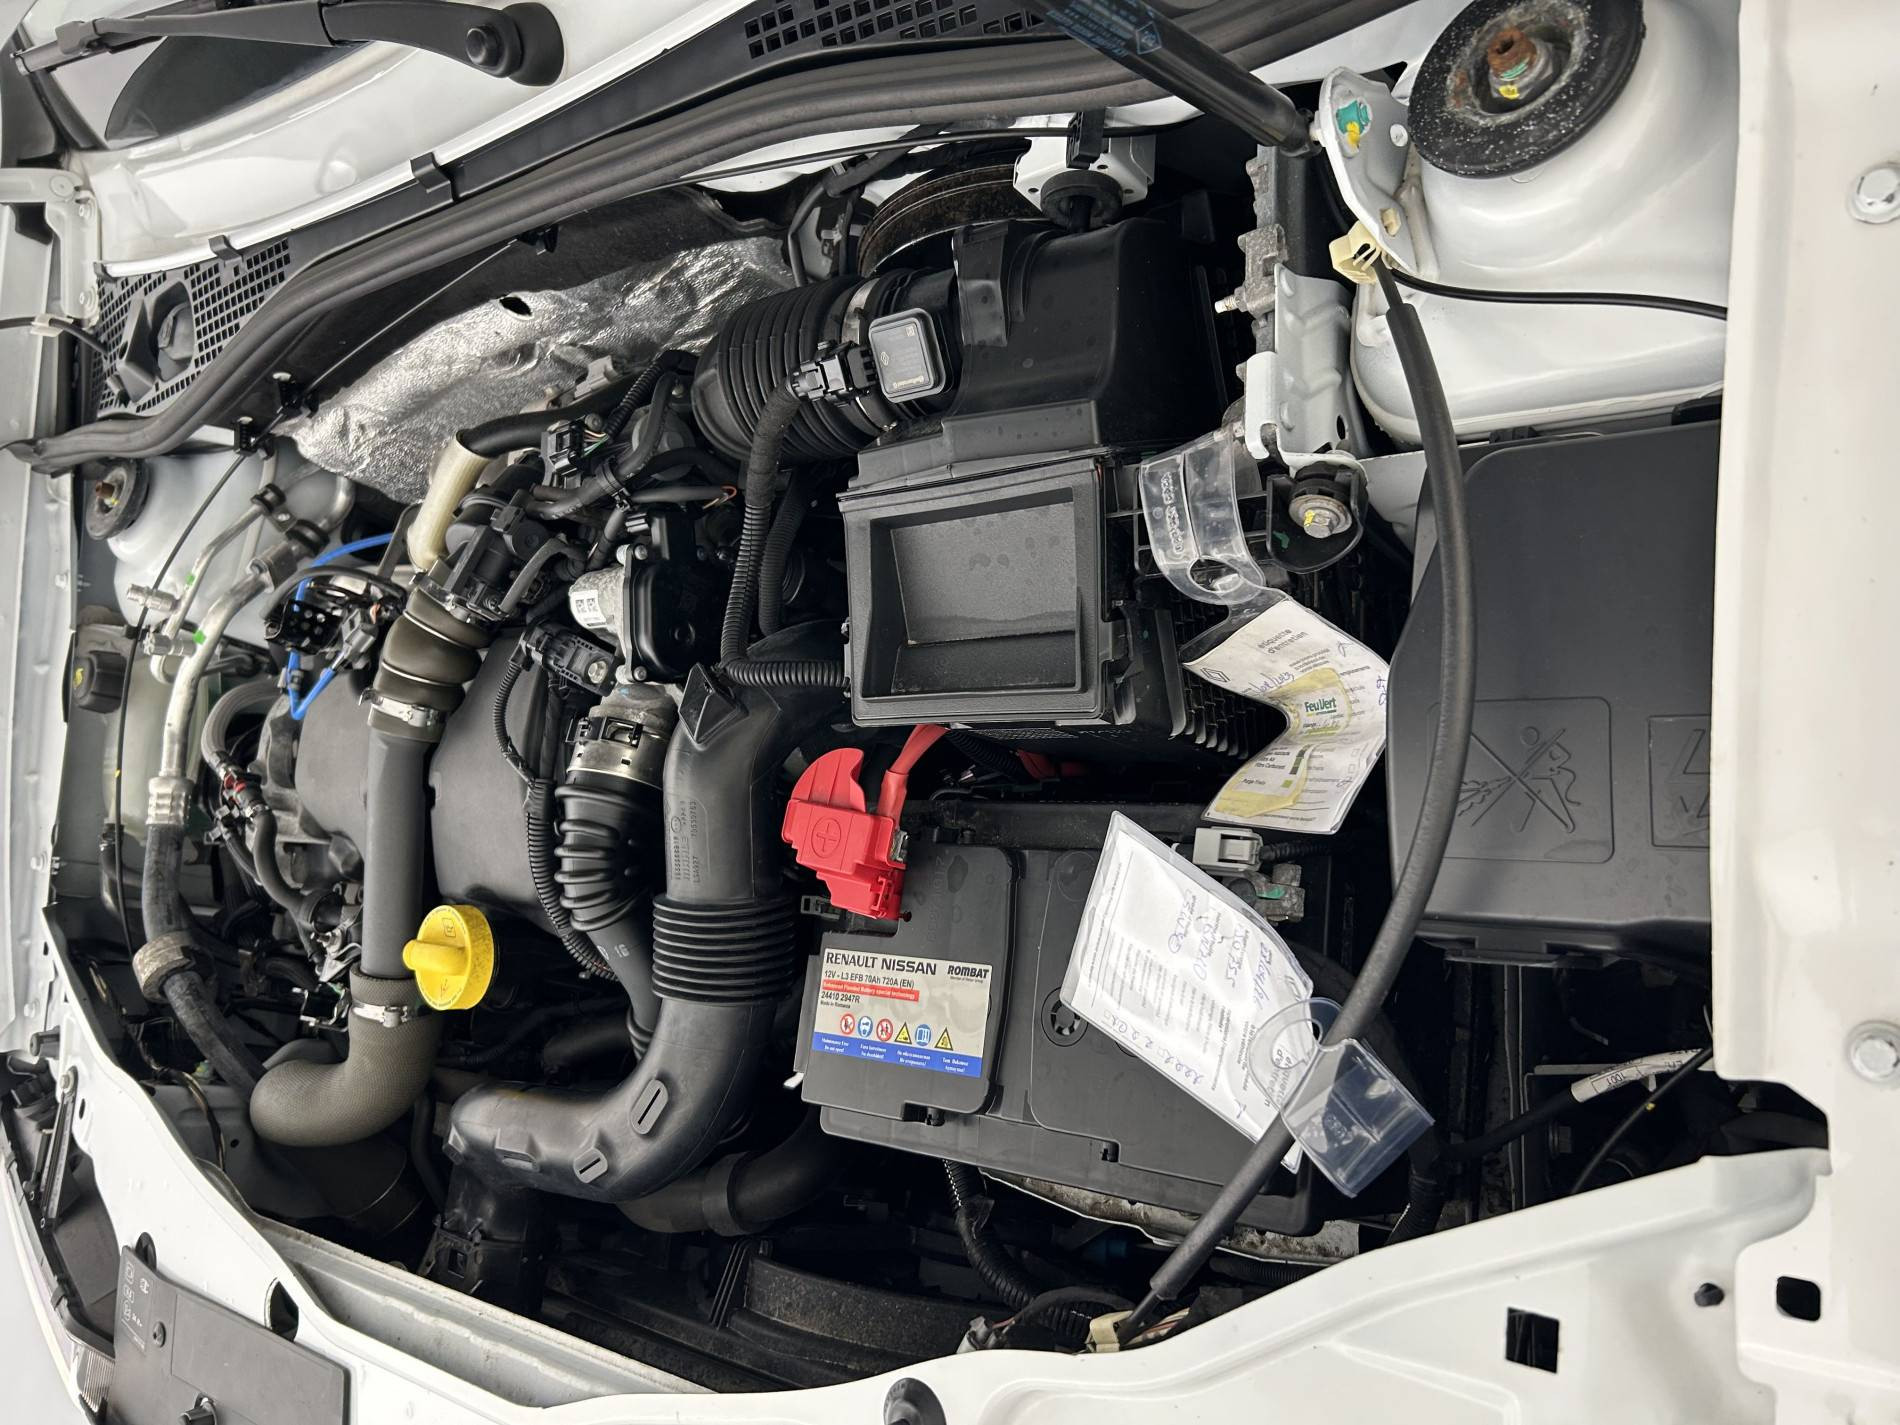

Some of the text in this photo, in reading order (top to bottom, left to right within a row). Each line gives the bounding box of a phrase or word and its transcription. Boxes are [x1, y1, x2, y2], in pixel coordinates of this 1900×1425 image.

[825, 951, 937, 975] RENAULT NISSAN
[824, 970, 835, 978] 12V
[841, 972, 849, 980] L3
[849, 973, 863, 982] EFB
[864, 975, 881, 984] 70Ah
[882, 977, 899, 986] 720A
[899, 979, 914, 989] (EN)
[820, 991, 860, 1003] 24410 2947R
